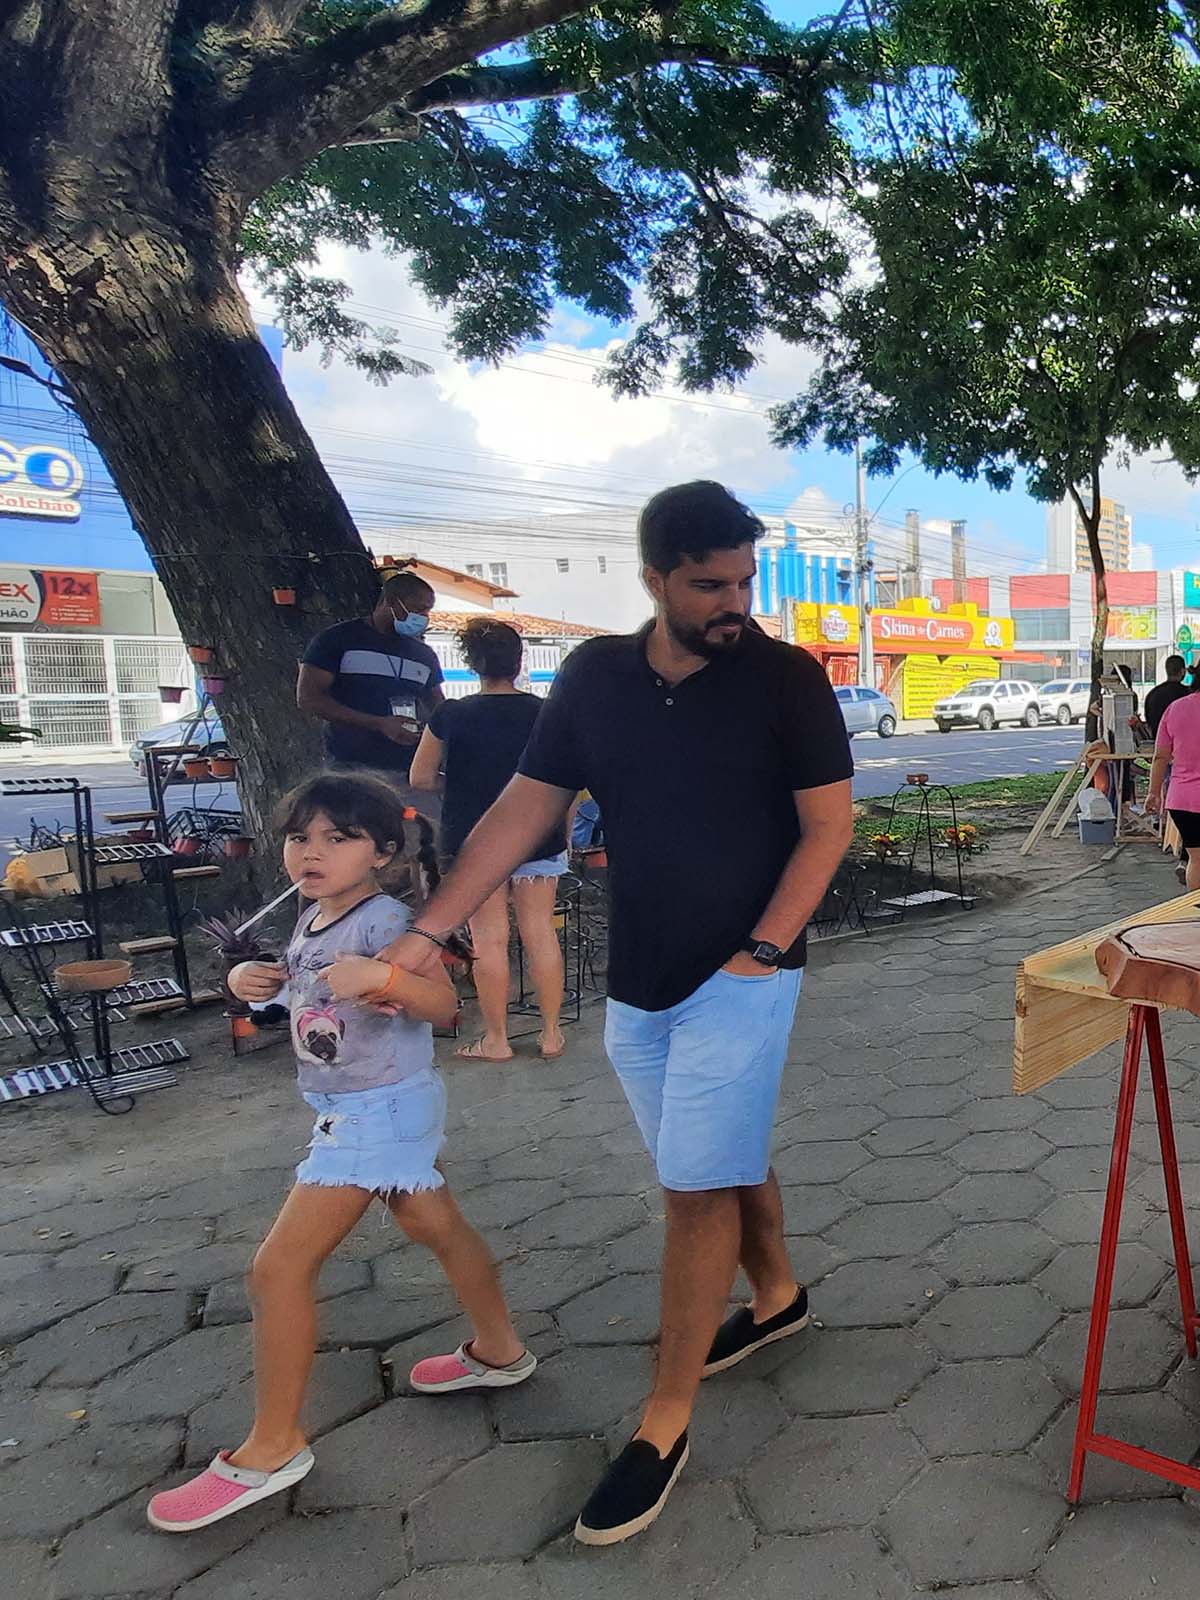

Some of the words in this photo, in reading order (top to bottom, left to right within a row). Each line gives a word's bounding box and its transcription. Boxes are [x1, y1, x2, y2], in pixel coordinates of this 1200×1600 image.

[50, 576, 92, 596] 12x
[881, 616, 915, 638] Skina
[926, 620, 965, 640] Carnes
